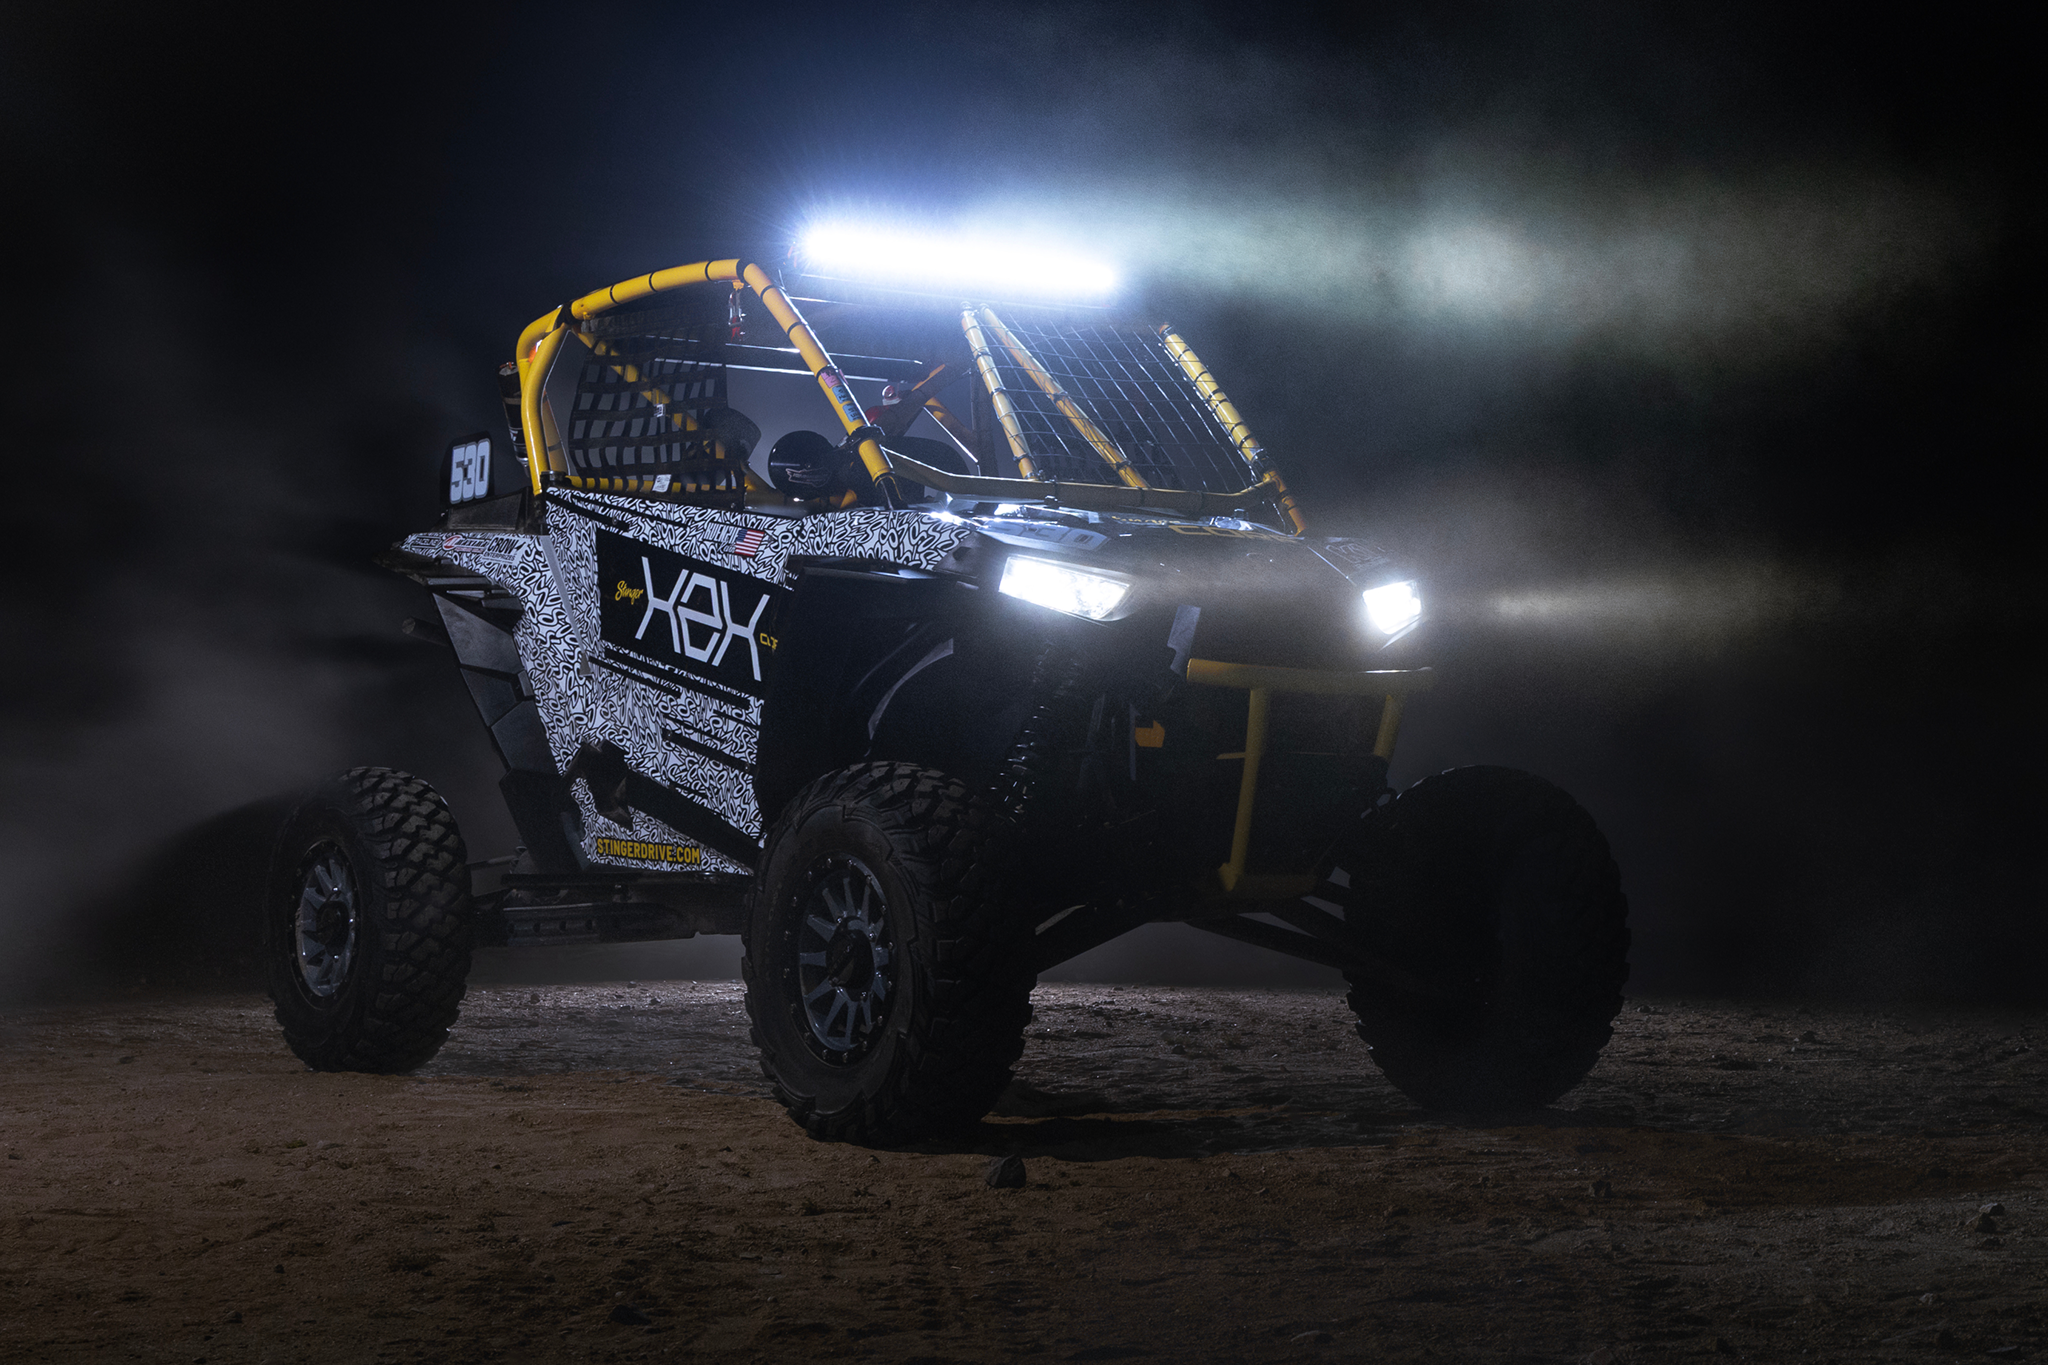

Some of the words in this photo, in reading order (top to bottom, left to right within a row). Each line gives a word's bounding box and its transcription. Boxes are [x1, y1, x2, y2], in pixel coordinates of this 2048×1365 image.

[449, 438, 491, 505] 530
[487, 536, 521, 555] CROW
[615, 580, 644, 606] Stinger
[597, 837, 700, 865] STINGERDRIVE.COM
